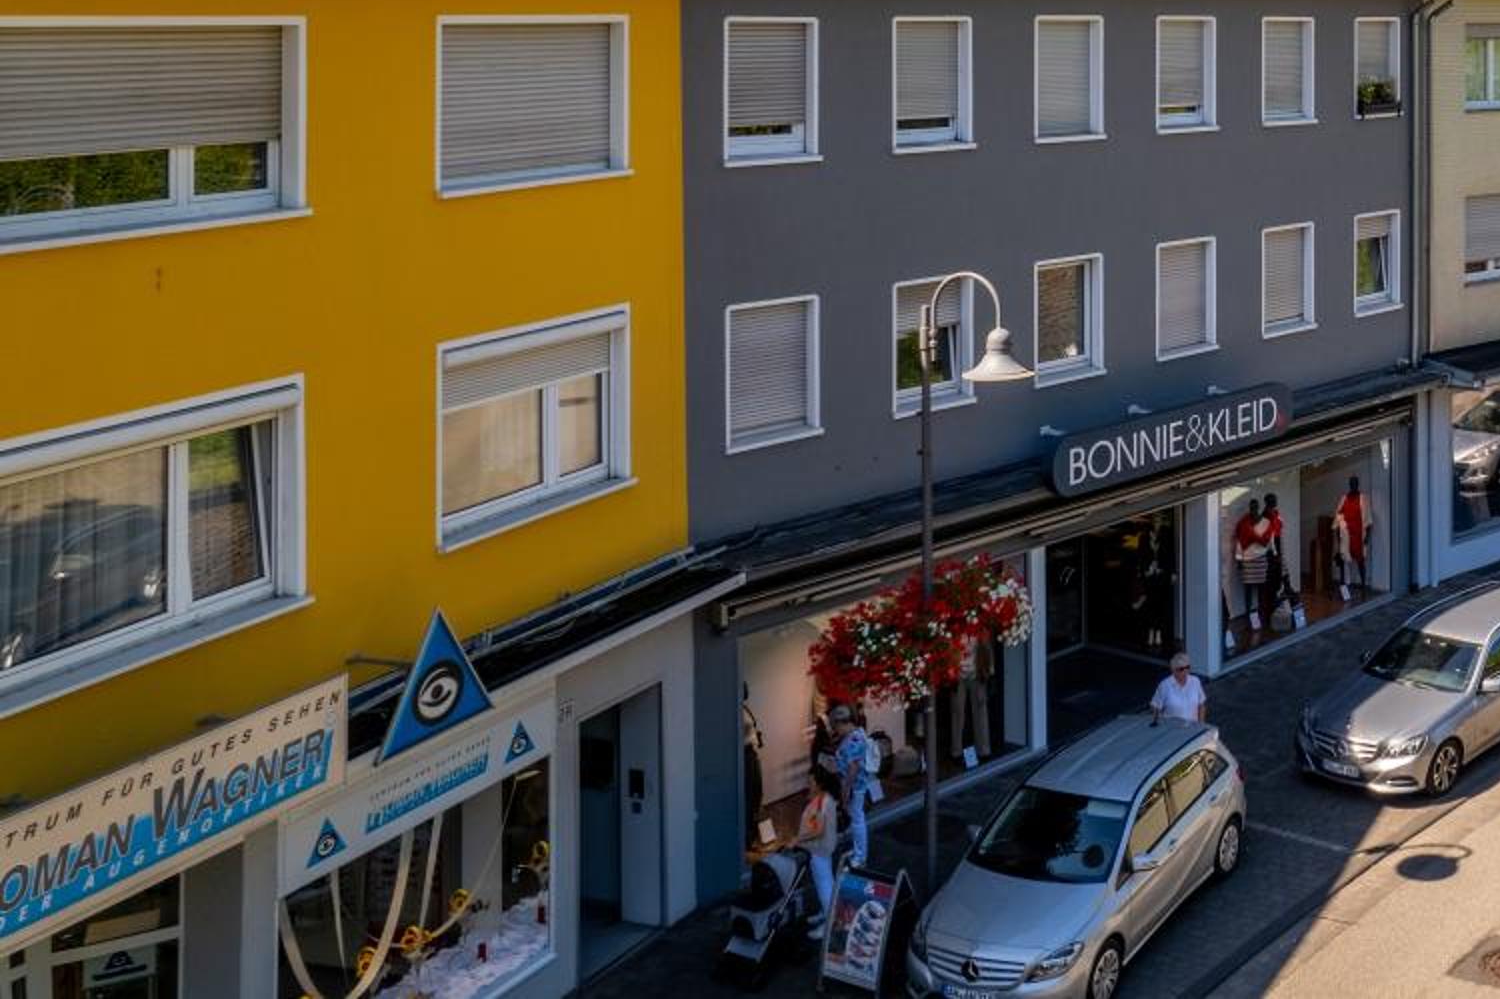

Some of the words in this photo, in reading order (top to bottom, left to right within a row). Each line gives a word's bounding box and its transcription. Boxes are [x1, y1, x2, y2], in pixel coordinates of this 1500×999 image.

[1068, 397, 1278, 486] BONNIE&KLEID
[6, 802, 83, 848] TRUM
[102, 772, 153, 806] FÜR
[171, 728, 253, 775] GUTES
[267, 688, 342, 733] SEHEN
[153, 728, 325, 839] WAGNER
[83, 765, 322, 892] AUGENOPTIKER
